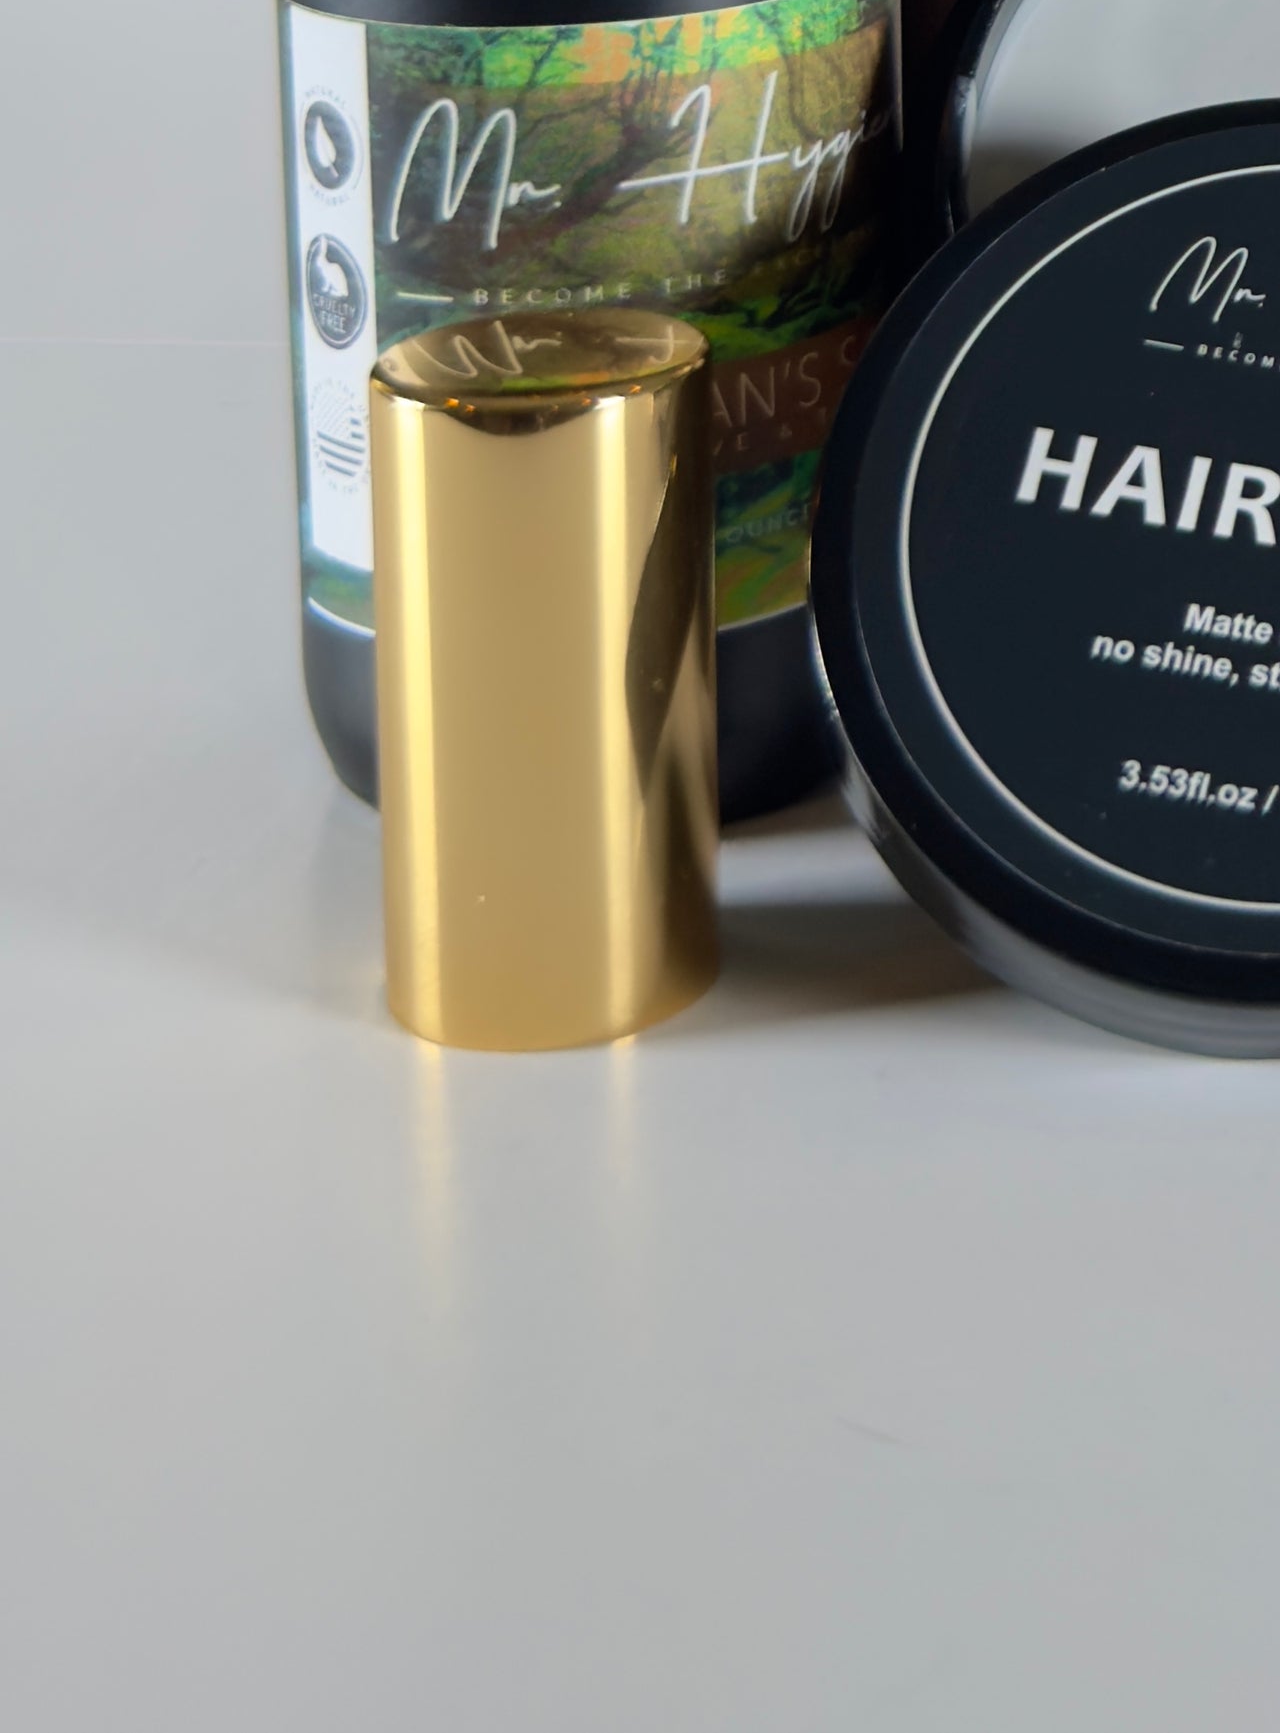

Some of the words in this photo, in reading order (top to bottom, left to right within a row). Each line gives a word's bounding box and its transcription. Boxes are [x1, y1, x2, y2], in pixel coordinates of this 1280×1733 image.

[387, 98, 561, 251] Mr.
[473, 281, 631, 306] BECOME
[664, 268, 727, 294] THE
[1148, 236, 1266, 323] Mr.
[1182, 602, 1274, 645] Matte
[1090, 634, 1135, 663] no
[1141, 641, 1240, 689] shine,
[1117, 758, 1260, 814] 3.53fl.oz
[1261, 784, 1280, 816] /
